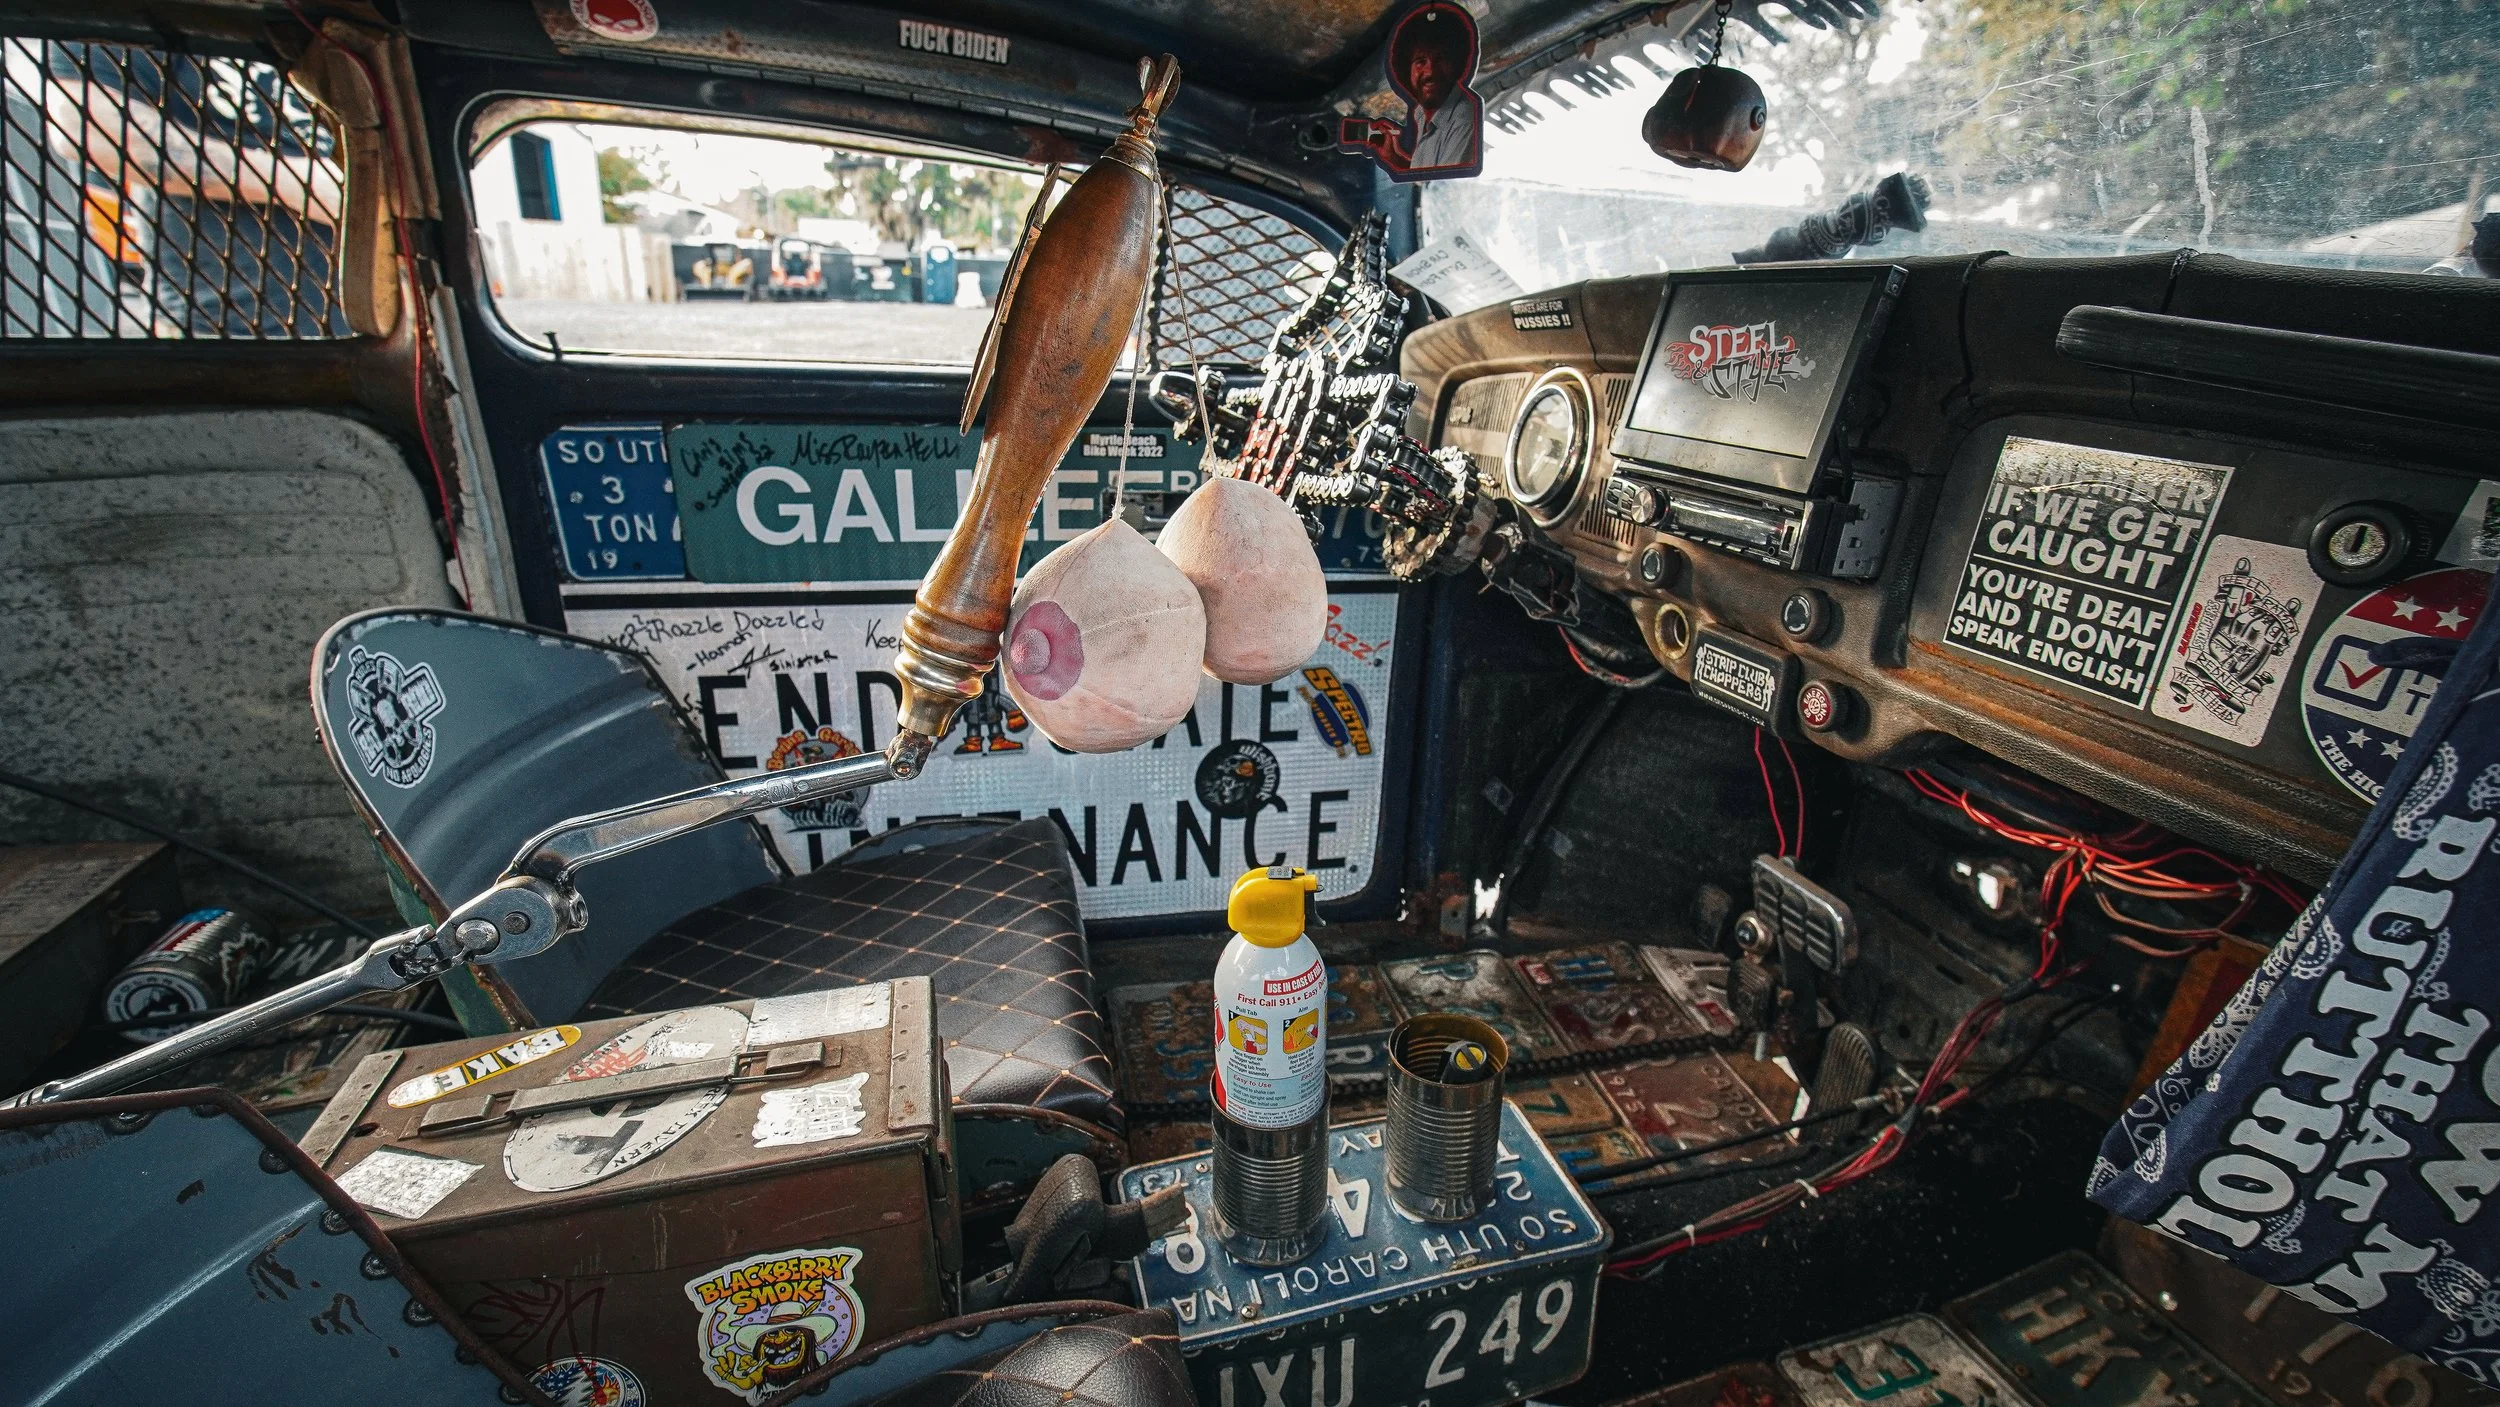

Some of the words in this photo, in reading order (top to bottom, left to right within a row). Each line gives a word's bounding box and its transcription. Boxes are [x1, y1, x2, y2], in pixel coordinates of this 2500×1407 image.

[899, 20, 950, 54] FUCK
[952, 28, 1009, 64] BIDEN
[1514, 314, 1561, 329] PUSSIES
[1561, 313, 1571, 326] !!
[1549, 300, 1563, 311] FOR
[1688, 320, 1791, 364] STEEL
[1692, 359, 1708, 380] &
[1709, 347, 1800, 403] STYLE
[1083, 445, 1106, 456] Bike
[1107, 445, 1136, 457] Wek
[1138, 445, 1163, 457] 2022
[602, 476, 625, 505] 3
[585, 514, 657, 543] TON
[1988, 483, 2023, 516] IF
[2034, 492, 2098, 532] WE
[2107, 506, 2203, 553] GET
[588, 552, 617, 570] 19
[1988, 520, 2175, 589] CAUGHT
[1969, 563, 2072, 613] YOU'RE
[2078, 593, 2166, 637] DEAF
[1957, 591, 2021, 627] AND
[2027, 610, 2041, 634] I
[2047, 615, 2156, 667] DON'T
[1705, 652, 1737, 673] STRIP
[1738, 664, 1766, 686] CLUB
[1950, 615, 2024, 654] SPEAK
[2026, 638, 2146, 694] ENGLISH
[2197, 653, 2252, 699] REDNECK
[1703, 665, 1763, 701] CHOPPERS
[1803, 689, 1828, 722] EMERGENCY
[1302, 667, 1372, 756] SPECTRO
[387, 768, 401, 782] NO
[402, 727, 432, 783] APOLOGIES
[2319, 735, 2348, 772] THE
[2349, 771, 2384, 799] HIG
[1237, 993, 1256, 1005] First
[1303, 989, 1317, 1000] Easy
[1267, 983, 1281, 993] USE
[1282, 981, 1291, 991] IN
[1291, 978, 1308, 990] CASE
[1307, 973, 1315, 982] OF
[437, 1028, 568, 1091] BAKE
[1233, 1074, 1248, 1084] Easy
[1248, 1069, 1269, 1077] assembly
[2315, 1003, 2492, 1222] THAT
[612, 1120, 686, 1169] TAVERN
[1420, 1208, 1577, 1263] SOUTH
[695, 1253, 855, 1306] BLACKBERRY
[731, 1278, 827, 1315] SMOKE
[1172, 1246, 1410, 1324] CAROLINA
[1425, 1278, 1574, 1390] 249
